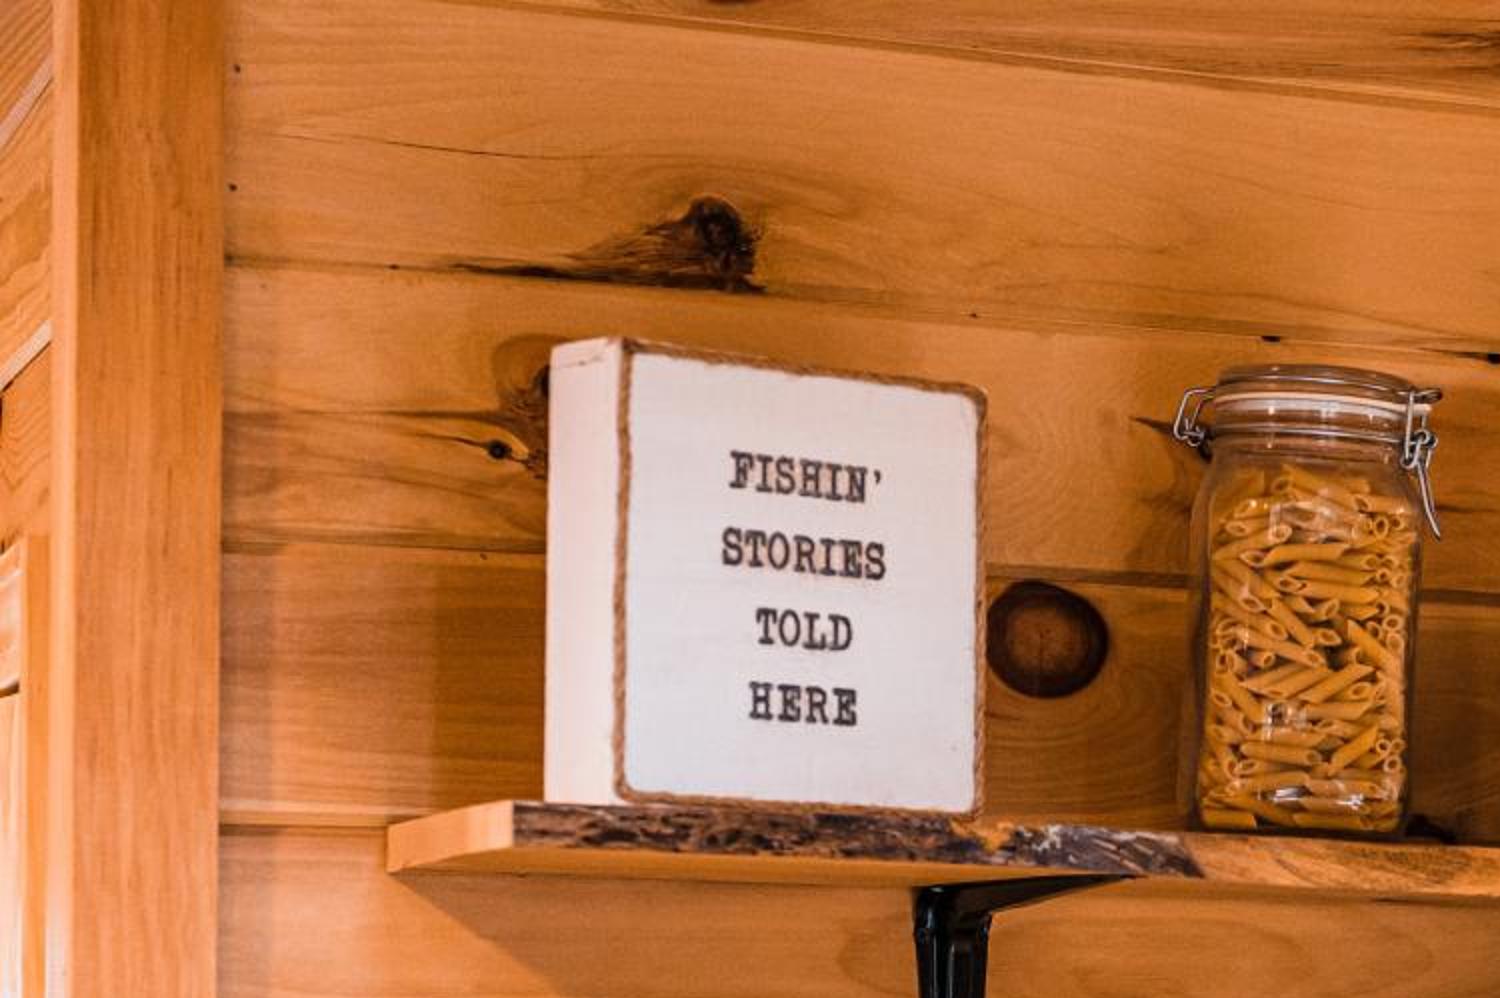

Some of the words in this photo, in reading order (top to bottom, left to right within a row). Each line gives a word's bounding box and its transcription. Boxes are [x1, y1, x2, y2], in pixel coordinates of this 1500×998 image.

[729, 450, 882, 504] FISHIN'
[722, 526, 887, 581] STORIES
[755, 607, 853, 652] TOLD
[749, 681, 858, 727] HERE
